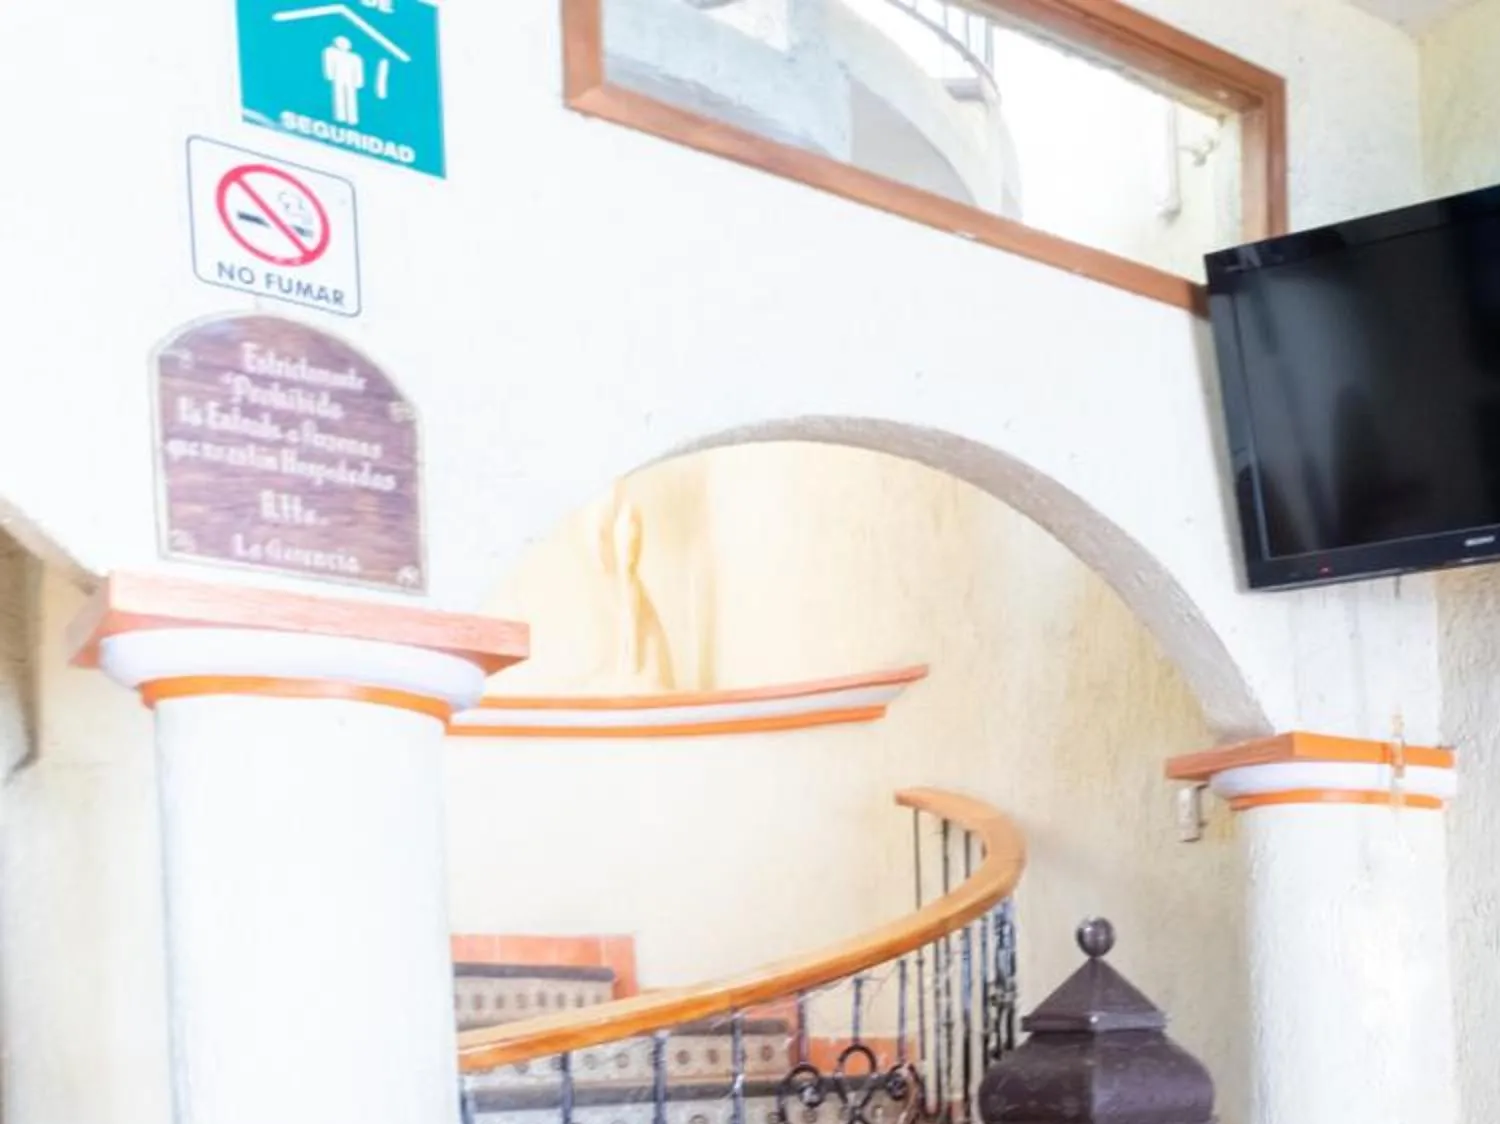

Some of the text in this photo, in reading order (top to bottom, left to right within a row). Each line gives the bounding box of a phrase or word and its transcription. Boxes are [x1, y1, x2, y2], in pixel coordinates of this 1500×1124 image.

[280, 109, 416, 162] SEGURIDAD
[216, 261, 345, 306] NO FUMAR
